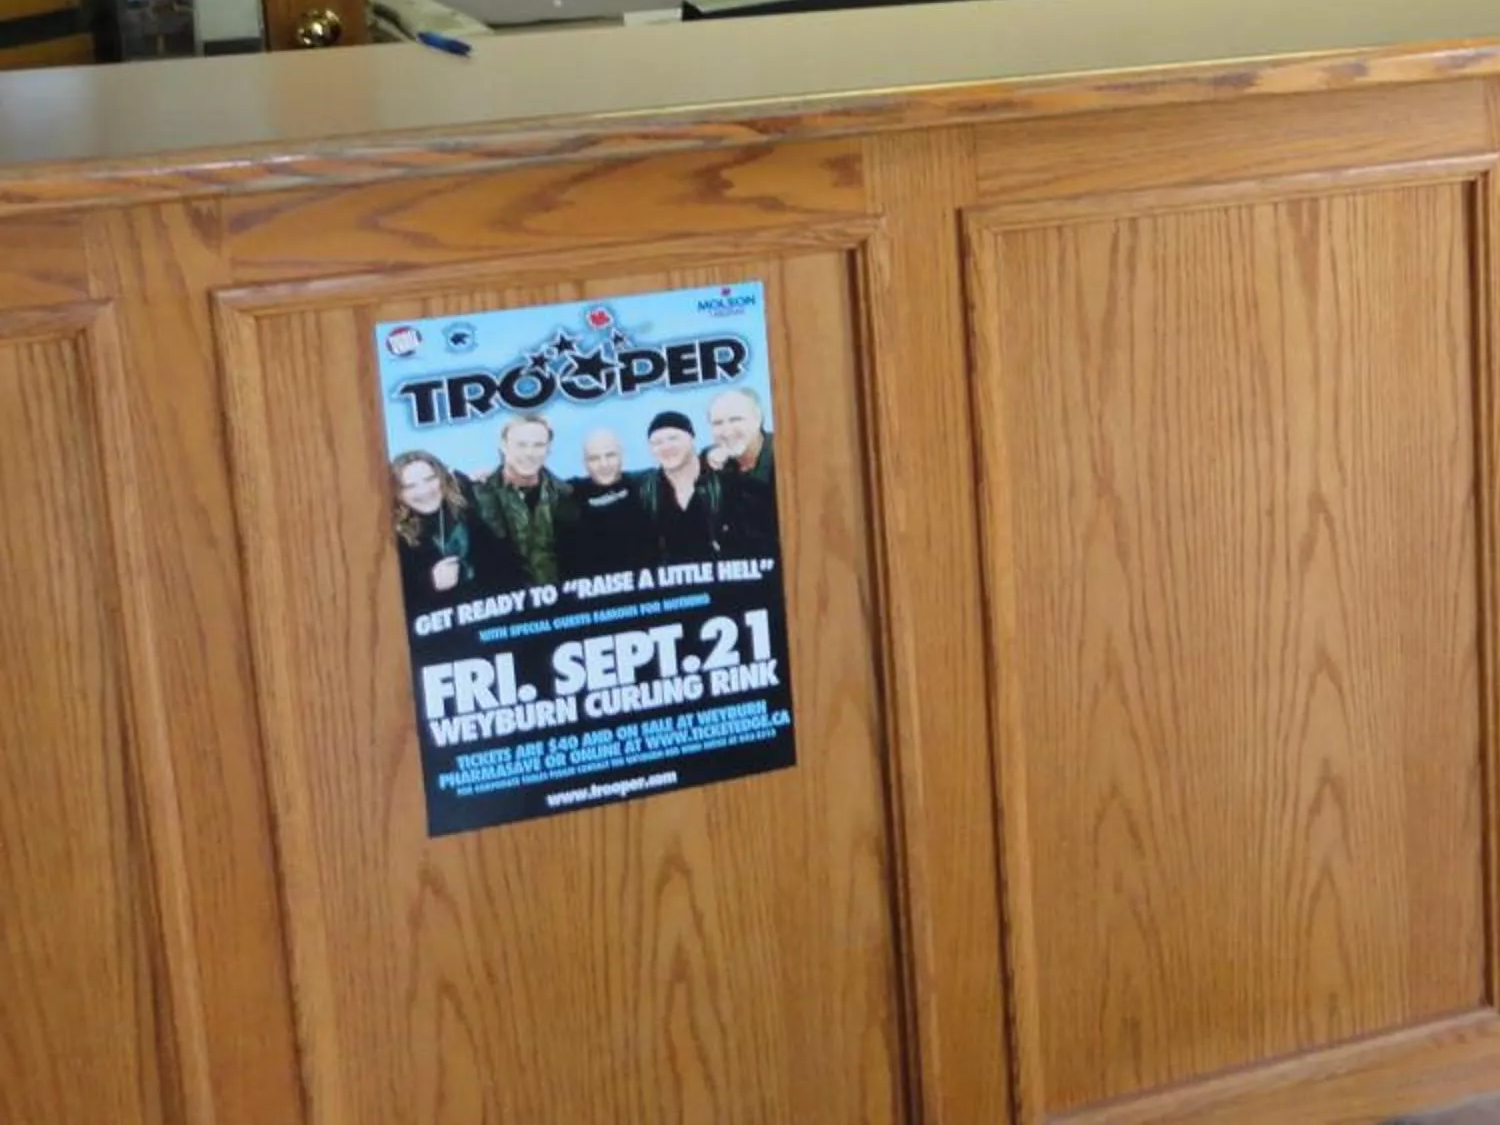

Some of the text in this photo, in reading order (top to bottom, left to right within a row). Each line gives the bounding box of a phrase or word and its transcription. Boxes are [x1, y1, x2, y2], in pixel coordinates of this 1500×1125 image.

[398, 335, 750, 426] TROOPER
[414, 608, 454, 636] GET
[457, 589, 526, 625] READY
[530, 584, 559, 608] TO
[638, 569, 655, 590] A
[658, 562, 714, 587] LITTLE
[510, 619, 551, 639] SPECIAL
[553, 613, 592, 630] GUESTS
[422, 652, 537, 719] FRI.
[428, 659, 780, 748] WEYBURN CURLING RINK
[439, 755, 542, 790] PHARMASAVE
[544, 752, 567, 769] OR
[570, 741, 622, 764] ONLINE
[624, 737, 642, 755] AT
[456, 699, 768, 771] TICKETS ARE $40 AND ON SALE AT WEYBURN
[546, 770, 678, 808] www.trooper.com
